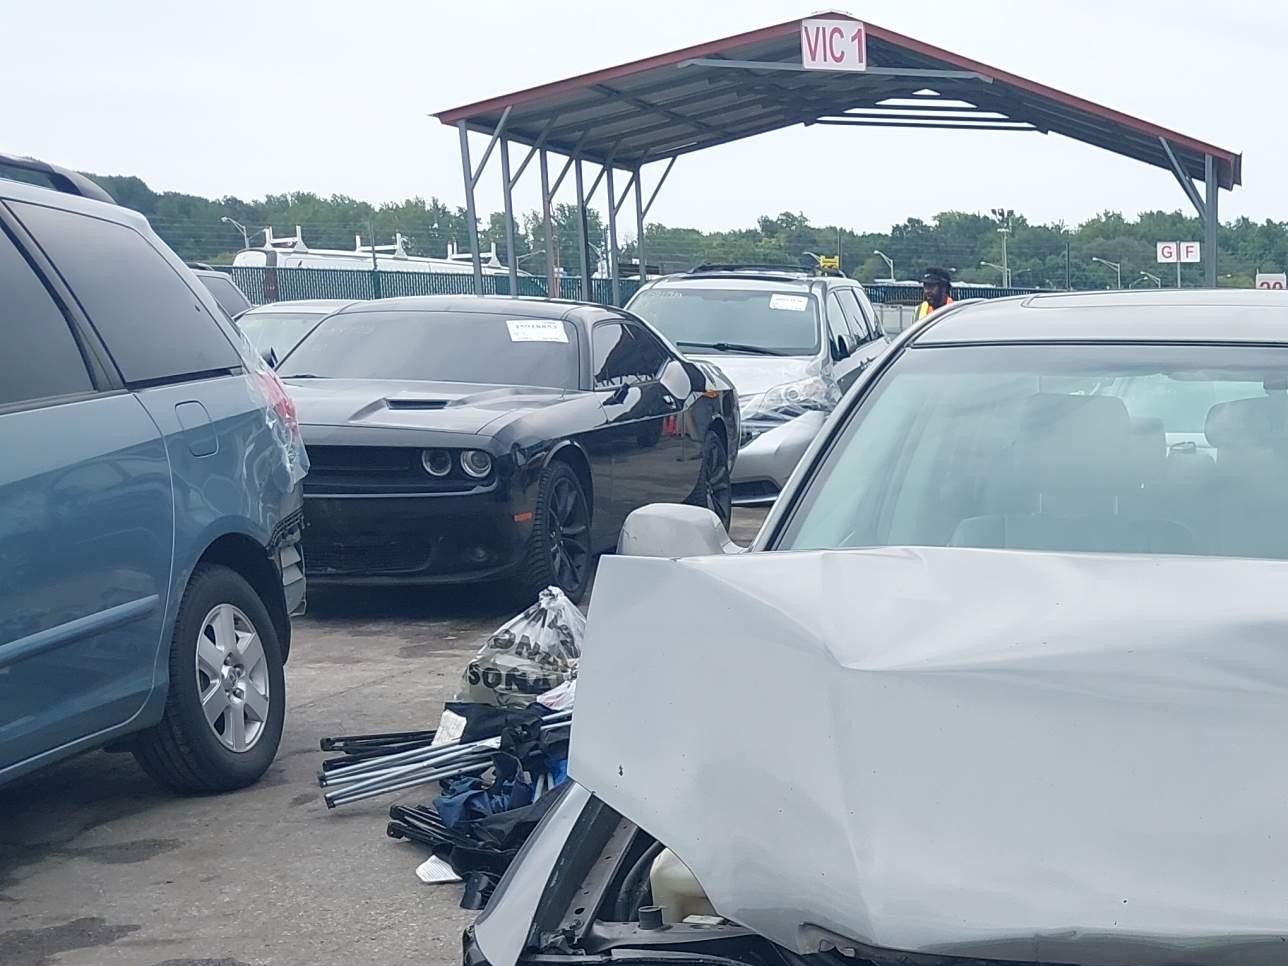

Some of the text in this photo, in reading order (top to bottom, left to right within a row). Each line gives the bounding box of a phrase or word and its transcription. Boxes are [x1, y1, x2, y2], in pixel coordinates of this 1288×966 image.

[804, 26, 864, 64] VIC 1
[1161, 245, 1173, 259] G
[1185, 245, 1195, 259] F
